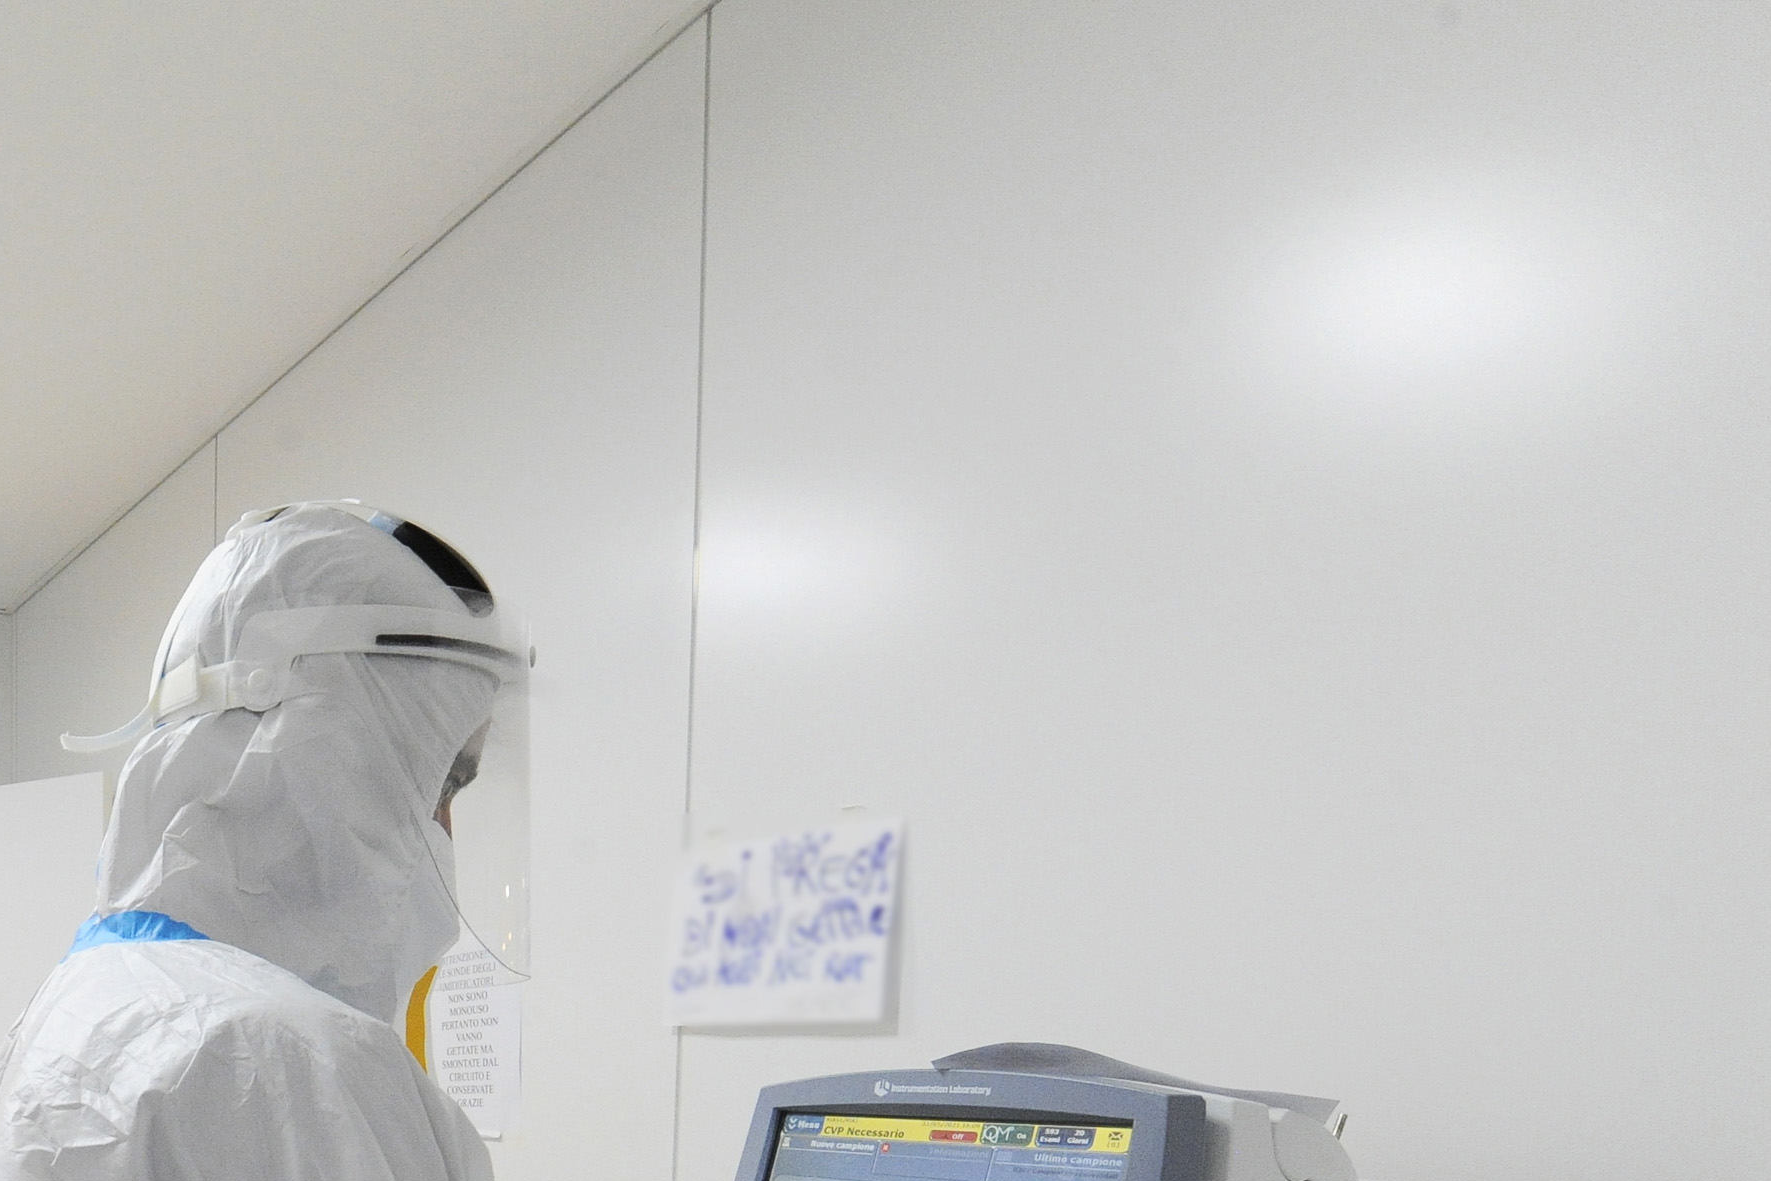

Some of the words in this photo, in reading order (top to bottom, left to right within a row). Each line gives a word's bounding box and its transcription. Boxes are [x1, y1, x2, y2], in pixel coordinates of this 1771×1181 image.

[447, 965, 471, 977] SONDE
[472, 962, 496, 974] DEGLI
[448, 994, 464, 1003] NON
[466, 991, 488, 1001] SONO
[449, 1005, 488, 1016] MONOUSO
[441, 1020, 479, 1031] PERTANTO
[481, 1017, 498, 1026] NON
[456, 1032, 482, 1041] VANNO
[447, 1046, 478, 1056] GETTATE
[480, 1044, 494, 1054] MA
[442, 1058, 481, 1069] SMONTATE
[482, 1057, 499, 1067] DAL
[449, 1072, 484, 1082] CIRCUITO
[486, 1071, 491, 1080] E
[447, 1085, 494, 1094] CONSERVATE
[891, 1084, 948, 1094] Instrumentation
[948, 1085, 992, 1096] Laboratory
[457, 1098, 484, 1107] GRAZIE
[797, 1120, 820, 1129] Menu
[824, 1126, 844, 1135] CVP
[847, 1127, 905, 1139] Necessario
[810, 1140, 835, 1149] Nuovo
[836, 1141, 875, 1151] campione
[1040, 1136, 1061, 1144] Esami
[1067, 1137, 1089, 1145] Giorni
[1034, 1153, 1067, 1163] Ultimo
[1070, 1157, 1123, 1167] campione
